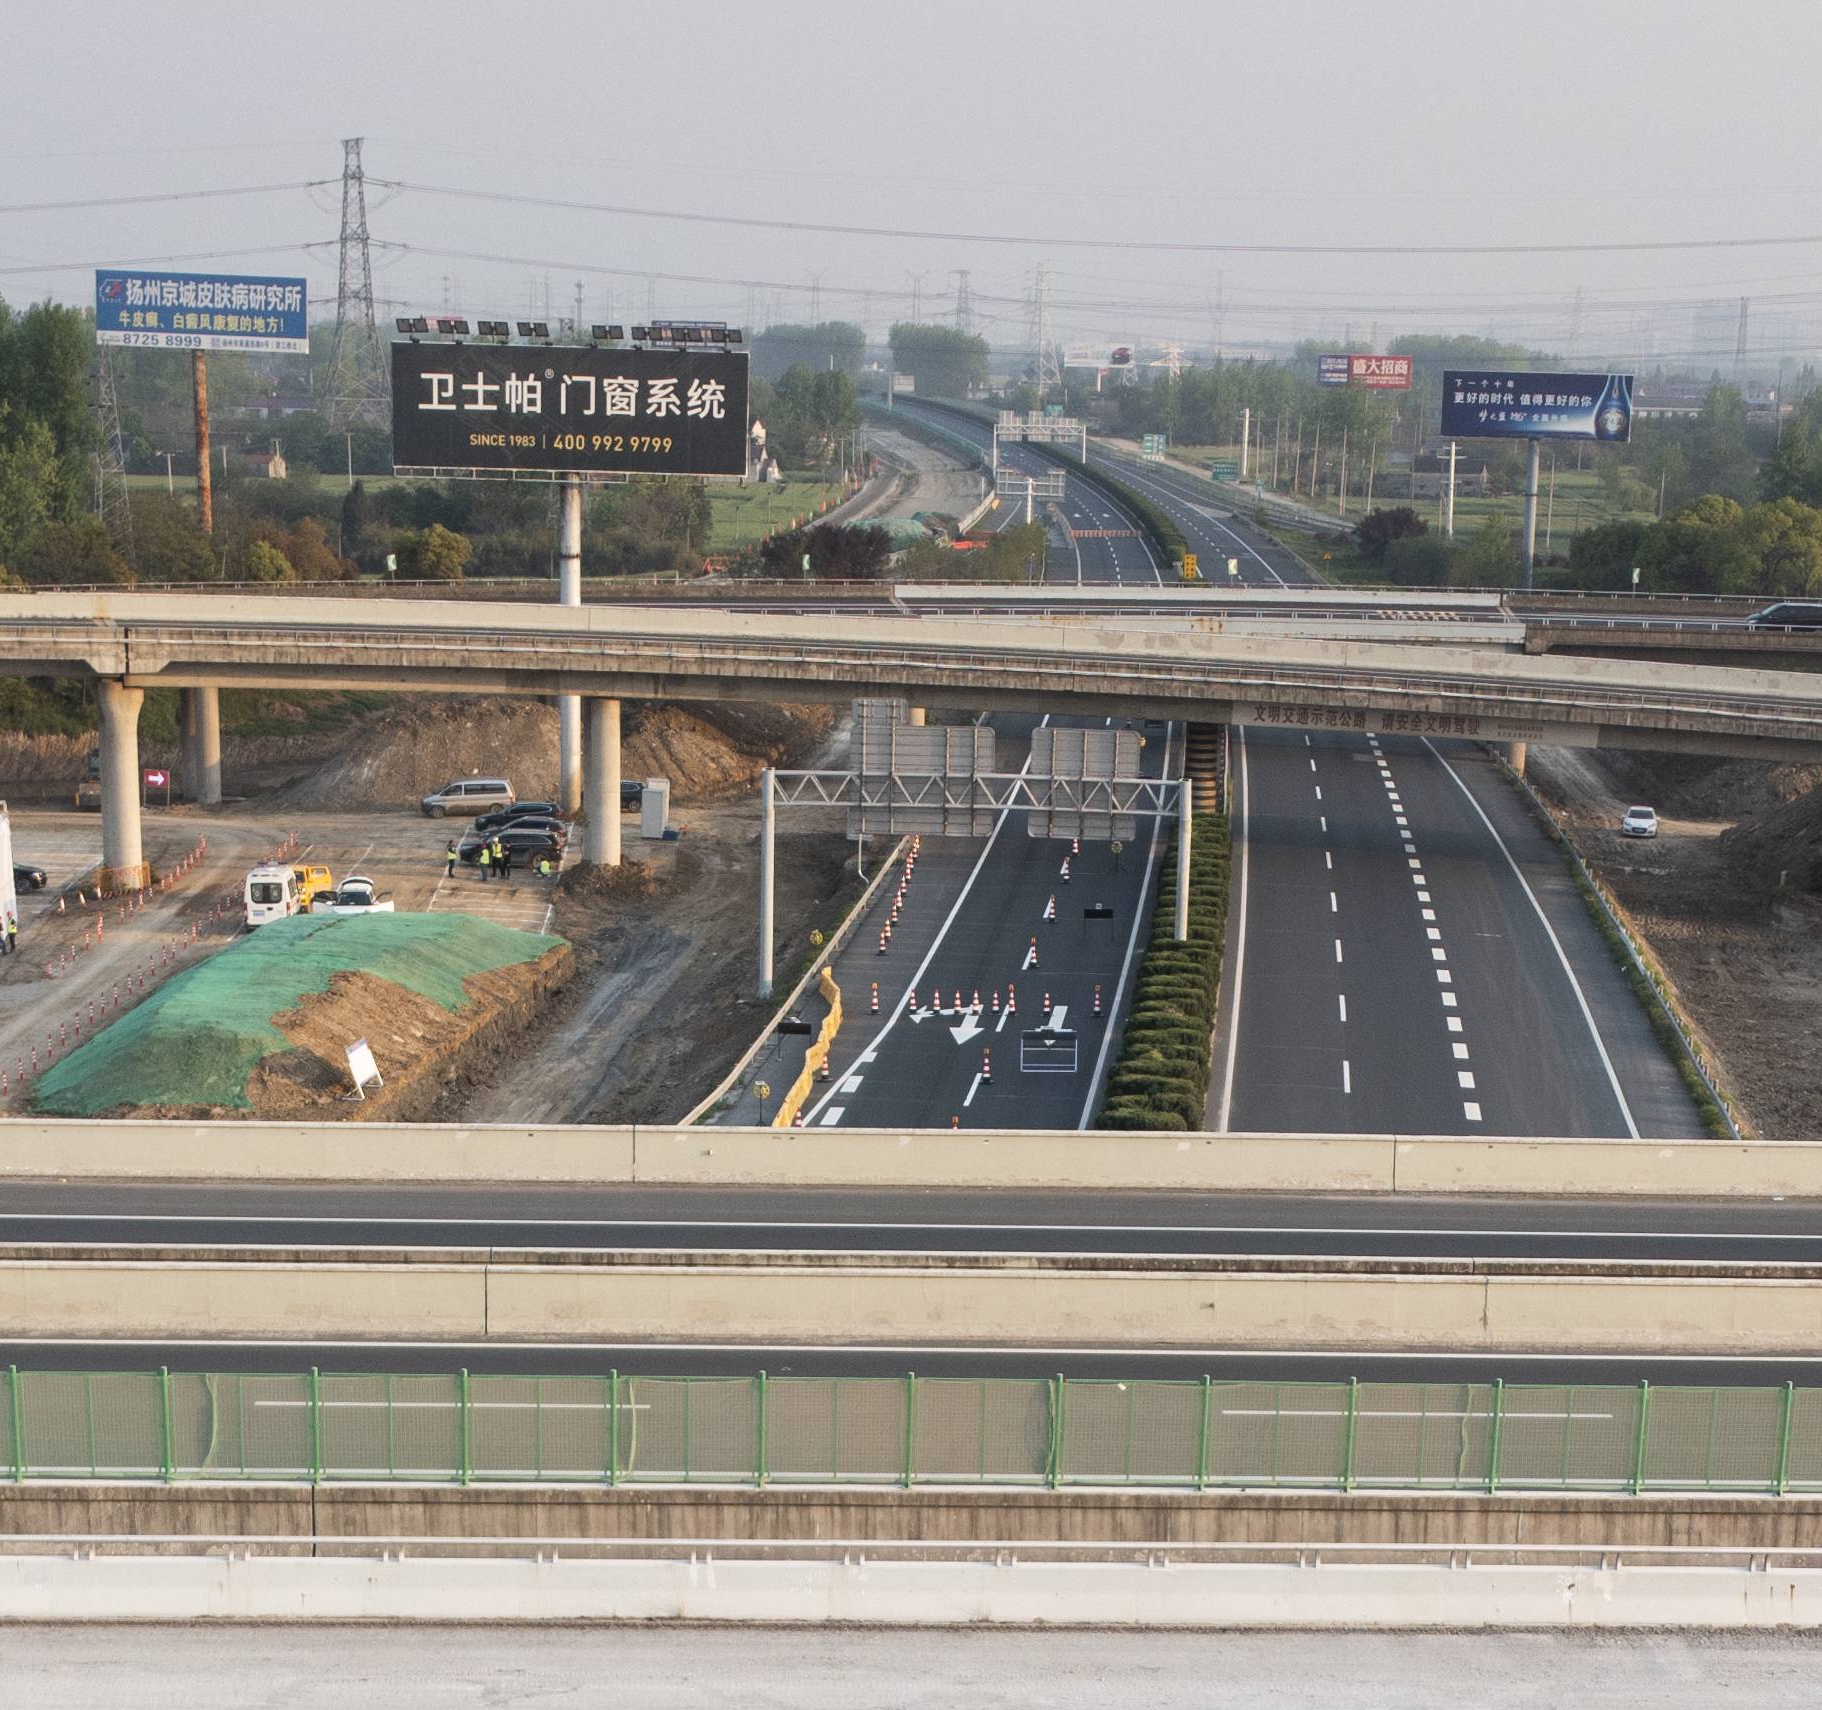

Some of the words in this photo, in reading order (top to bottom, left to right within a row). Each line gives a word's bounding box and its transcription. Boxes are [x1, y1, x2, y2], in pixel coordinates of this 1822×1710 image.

[126, 278, 302, 312] 扬州京城皮肤病研究所
[123, 334, 159, 346] 8725
[165, 335, 202, 347] 8999
[1353, 359, 1408, 375] 盛大招商
[1453, 391, 1514, 405] 更好的时代
[1519, 393, 1592, 407] 值得更好的你
[469, 433, 506, 447] SINCE
[509, 434, 536, 448] 1983
[553, 435, 585, 451] 400
[592, 435, 624, 452] 992
[630, 437, 672, 453] 9799
[1252, 704, 1367, 730] 文明交通示范公路
[1381, 713, 1480, 736] 请安全文明驾驶
